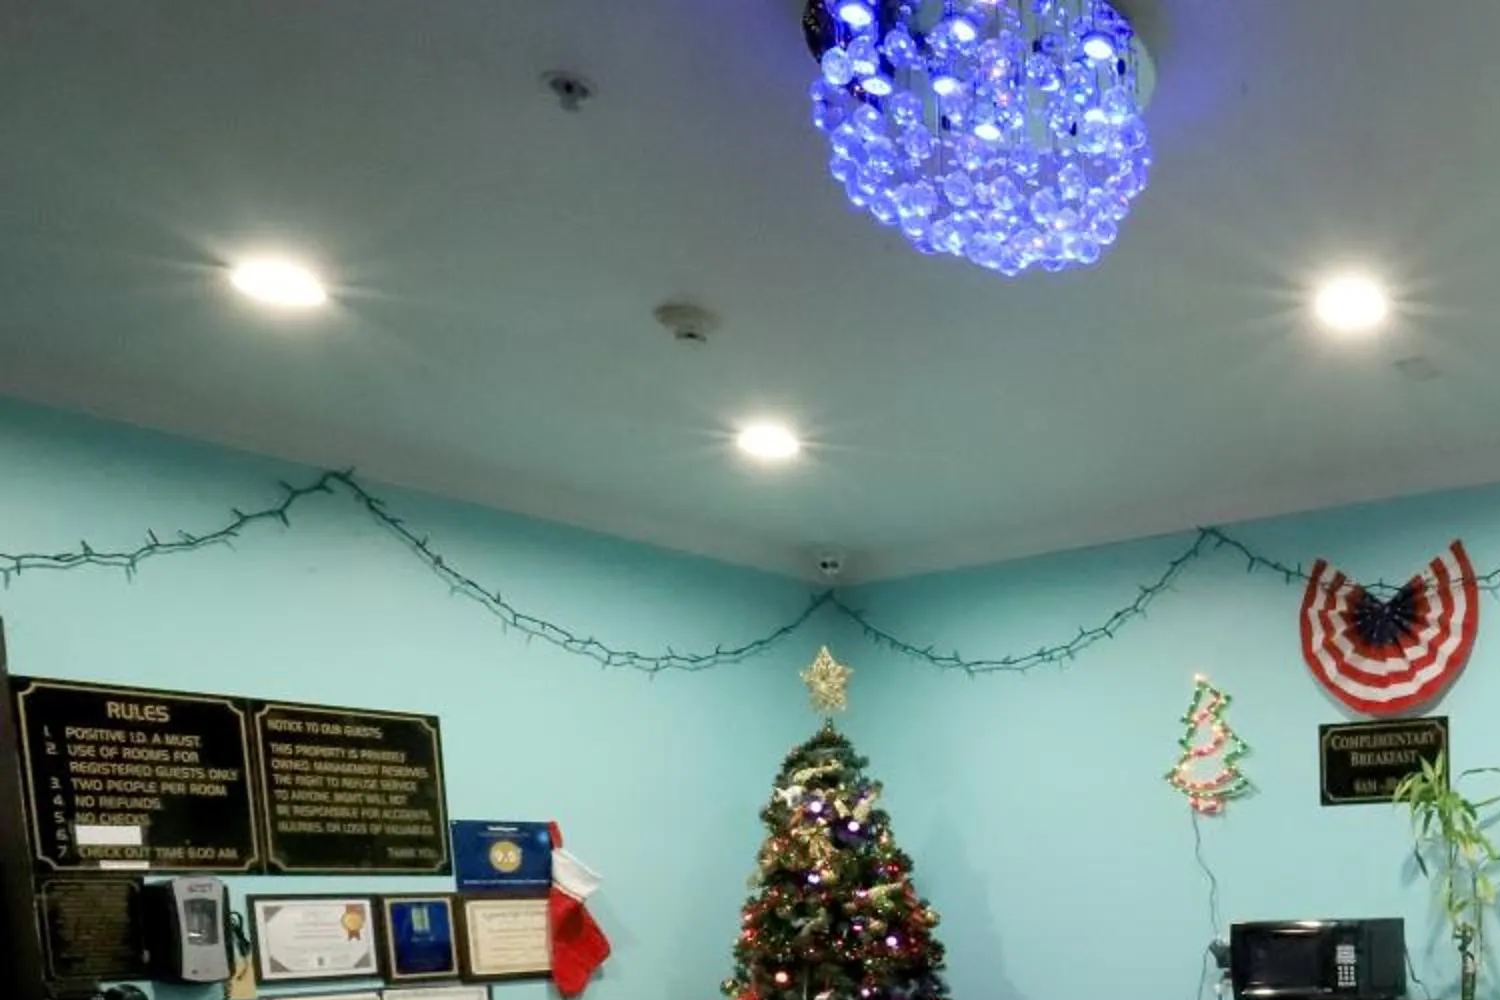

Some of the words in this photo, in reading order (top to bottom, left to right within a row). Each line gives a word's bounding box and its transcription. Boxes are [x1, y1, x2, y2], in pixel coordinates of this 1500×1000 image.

[106, 701, 170, 723] RULES
[65, 727, 126, 743] POSITIVE
[152, 734, 162, 745] A
[306, 722, 319, 733] TO
[67, 744, 96, 758] USE
[100, 745, 119, 759] OF
[124, 747, 170, 762] ROOMS
[174, 751, 199, 763] FOR
[1351, 750, 1418, 767] BREAKFAST
[69, 761, 151, 777] REGISTERED
[155, 765, 205, 780] GUESTS
[71, 778, 103, 791] TWO
[107, 780, 158, 794] PEOPLE
[161, 783, 186, 795] PER
[190, 784, 228, 797] ROOM
[272, 774, 292, 785] THE
[327, 776, 338, 788] TO
[75, 795, 96, 808] NO
[75, 812, 96, 825] NO
